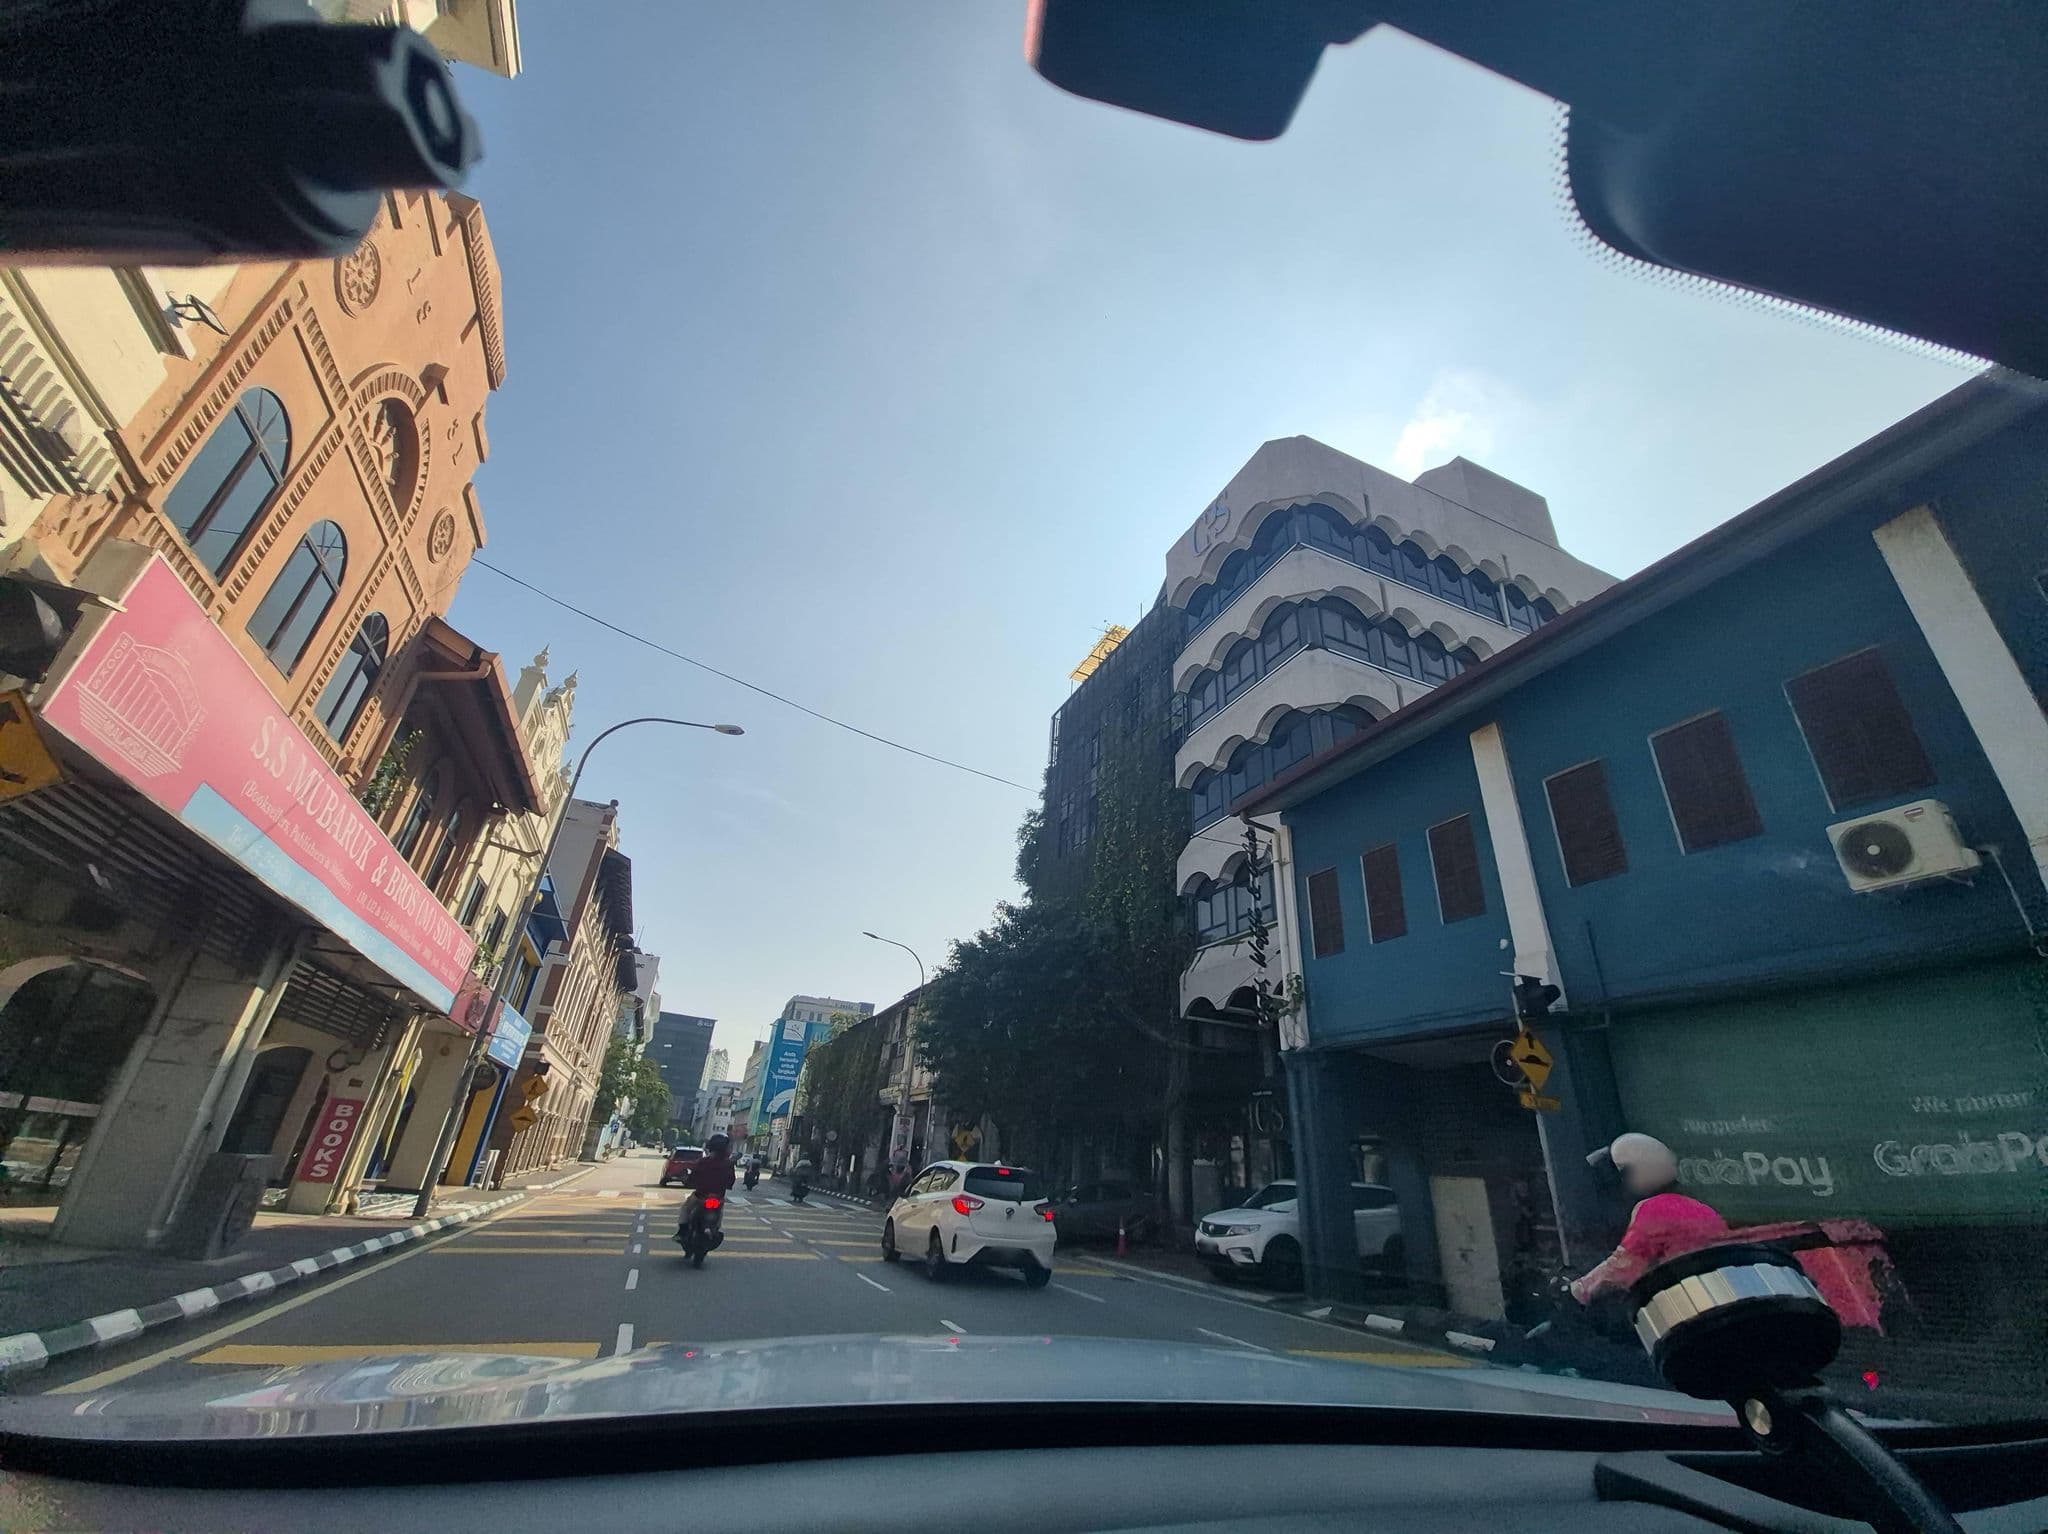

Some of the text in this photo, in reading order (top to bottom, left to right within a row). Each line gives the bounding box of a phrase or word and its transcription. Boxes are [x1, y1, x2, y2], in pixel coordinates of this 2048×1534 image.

[92, 638, 130, 690] BOOKS
[251, 715, 295, 778] S.S
[286, 752, 377, 872] MUBARUK
[371, 855, 388, 887] &
[384, 865, 419, 917] BROS
[415, 896, 437, 936] (M)
[310, 1104, 353, 1177] BOOKS
[1679, 1148, 1834, 1196] rabPay
